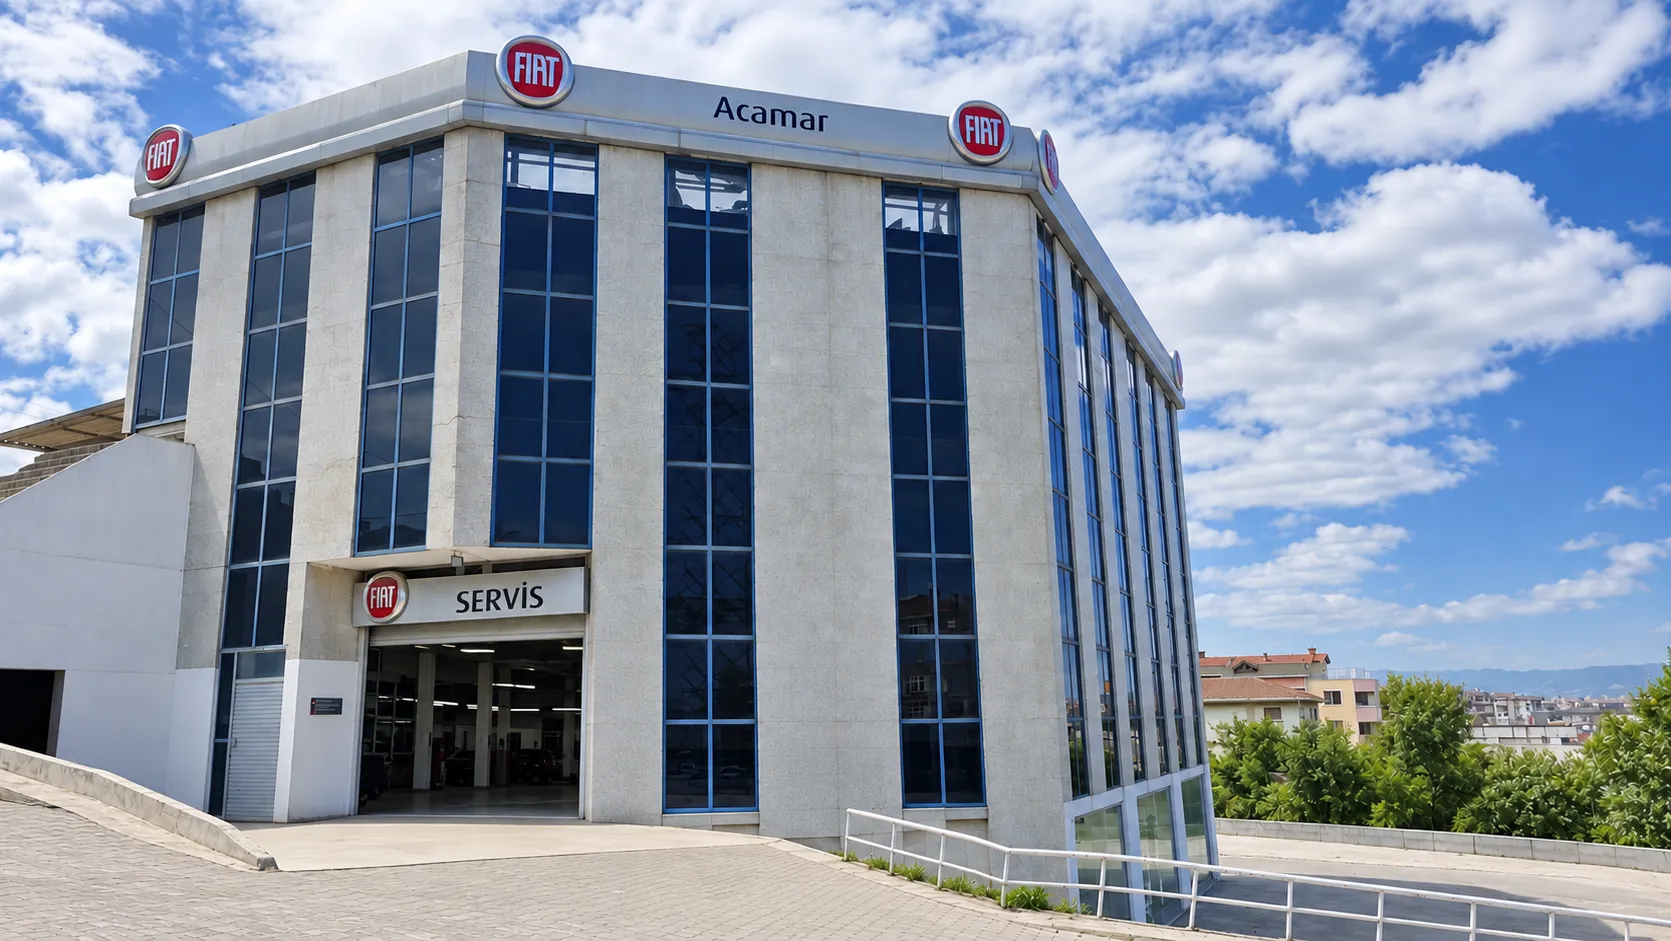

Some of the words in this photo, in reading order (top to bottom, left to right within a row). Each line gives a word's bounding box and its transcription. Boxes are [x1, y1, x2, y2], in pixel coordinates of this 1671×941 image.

[514, 51, 560, 88] FIAT
[713, 96, 829, 132] Acamar
[965, 114, 1002, 147] FIAT
[147, 138, 176, 171] FIAT
[370, 585, 396, 610] FIAT
[455, 581, 544, 614] SERVİS
